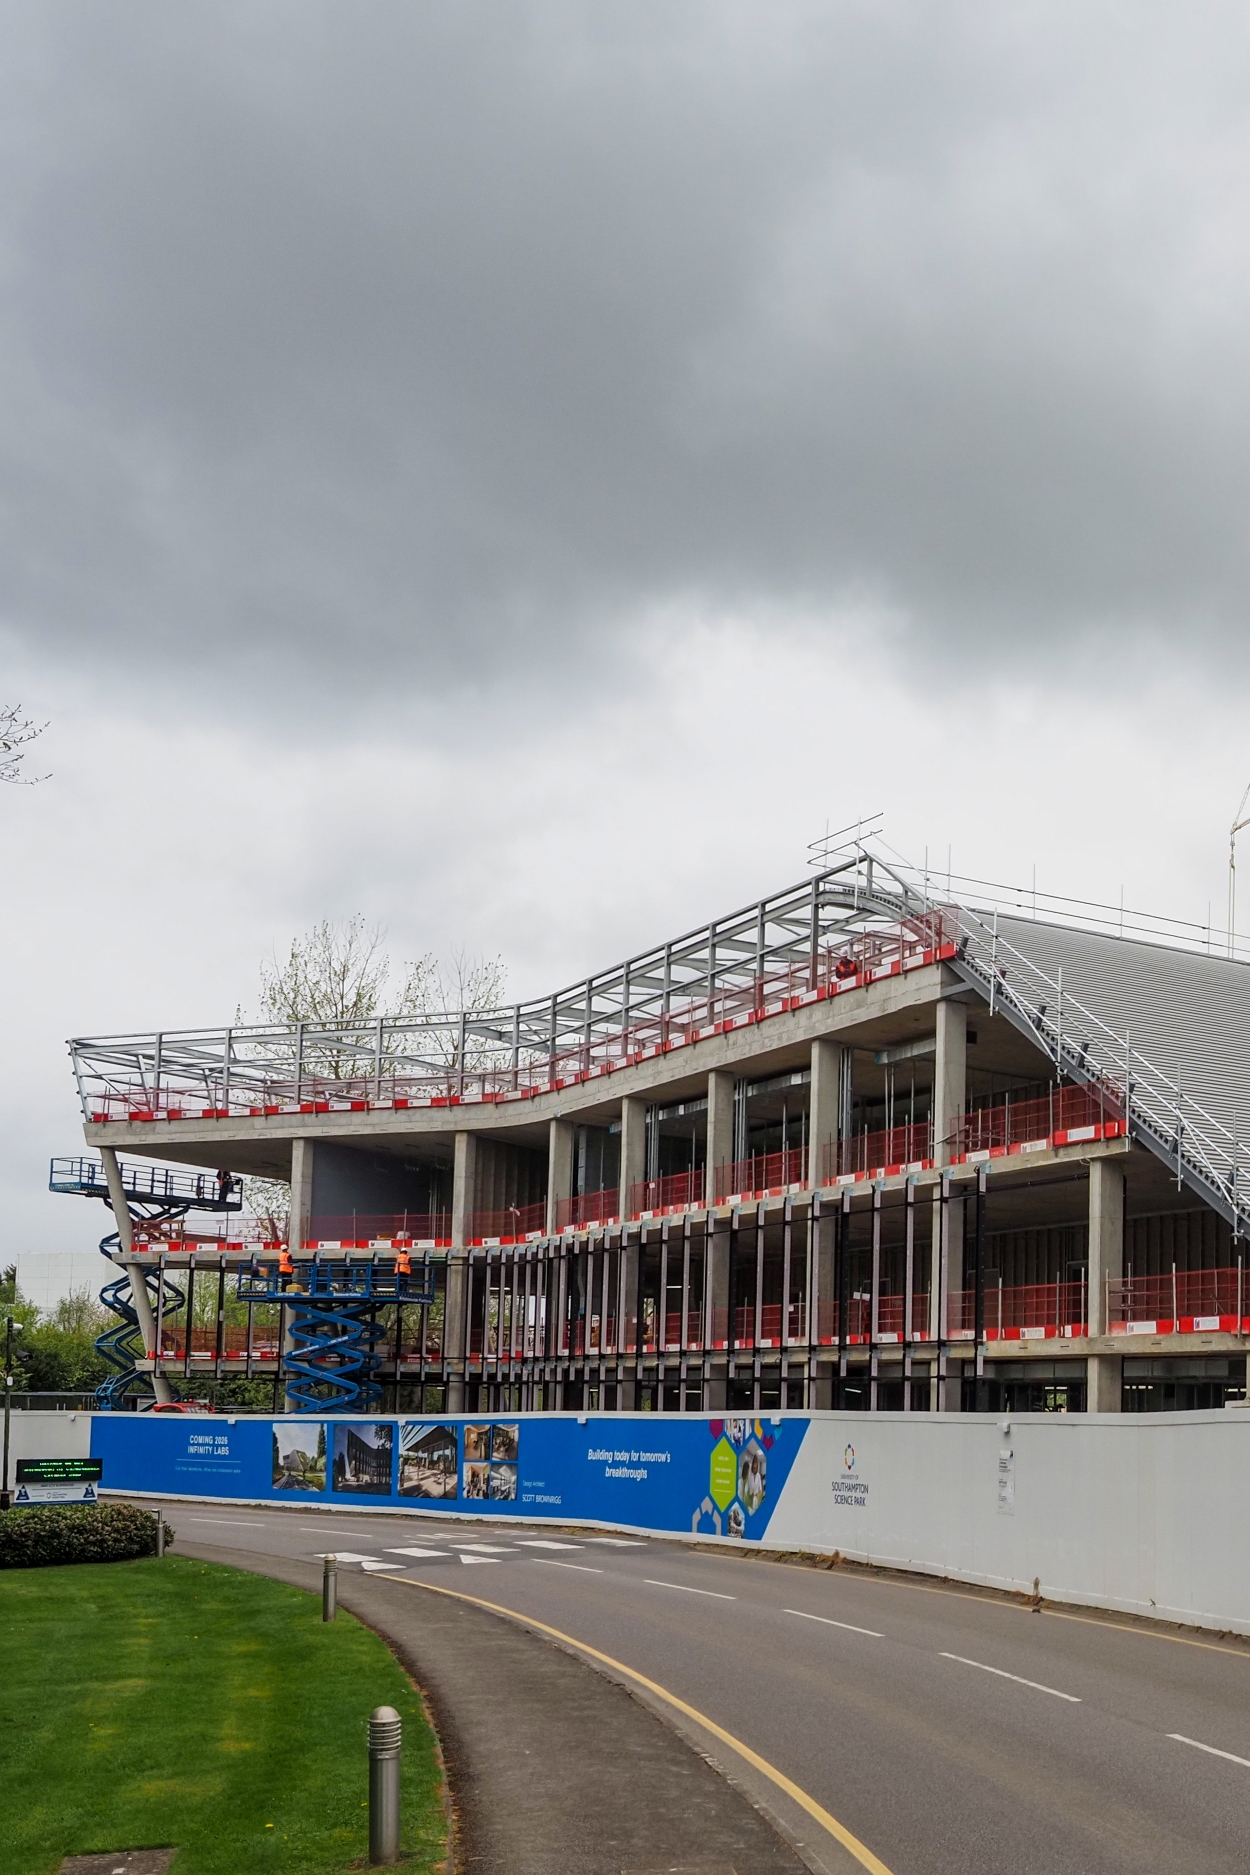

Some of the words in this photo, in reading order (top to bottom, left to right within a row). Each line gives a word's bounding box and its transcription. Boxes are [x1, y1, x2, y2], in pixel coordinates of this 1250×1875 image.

[189, 1435, 213, 1445] COMING
[187, 1445, 213, 1455] INFINITY
[213, 1446, 229, 1456] LABS
[588, 1448, 613, 1463] Building
[614, 1450, 630, 1464] today
[631, 1450, 640, 1462] for
[640, 1450, 671, 1463] tomorrow's
[605, 1466, 648, 1482] breakthroughs
[831, 1481, 869, 1494] SOUTHAMPTON
[522, 1494, 535, 1502] SCOTT
[834, 1494, 853, 1506] SCIENCE
[854, 1496, 867, 1506] PARK
